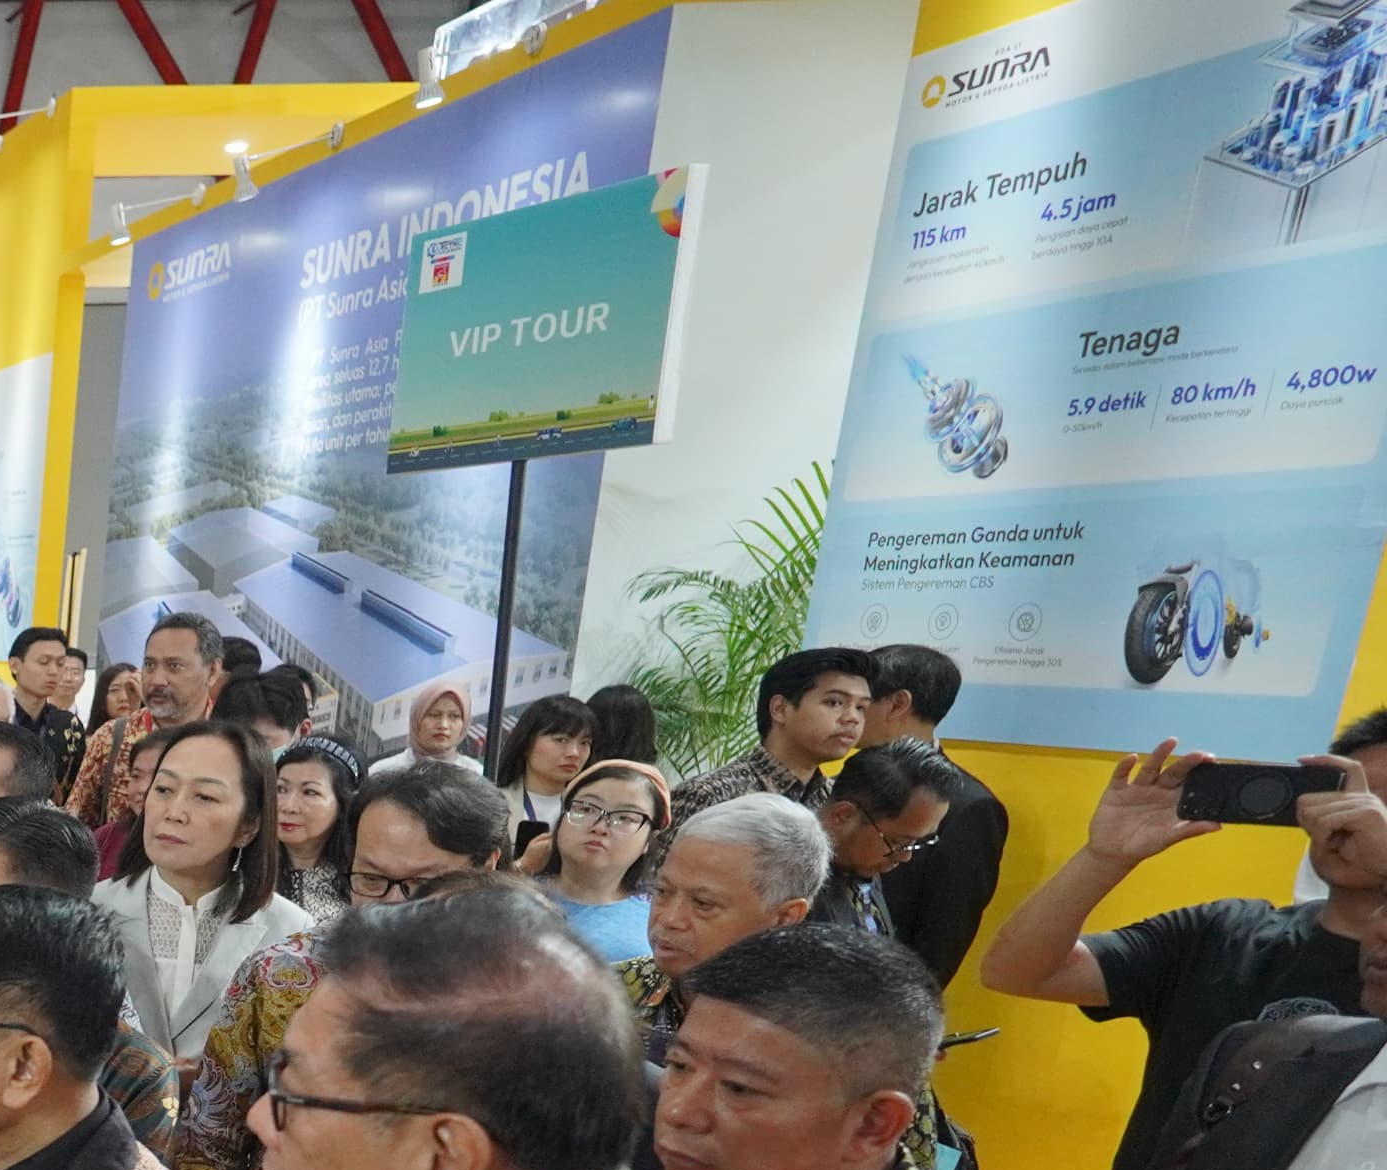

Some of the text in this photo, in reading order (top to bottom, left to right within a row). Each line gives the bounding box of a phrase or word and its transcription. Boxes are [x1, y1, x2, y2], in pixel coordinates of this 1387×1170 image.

[947, 47, 1051, 97] SUNRA
[913, 151, 1087, 218] Jarak Tempuh
[1041, 193, 1116, 222] 4.5 jam
[912, 225, 967, 250] 115 km
[163, 241, 231, 291] SUNRA
[300, 222, 391, 290] SUNRA
[326, 286, 373, 320] Sunra
[450, 323, 502, 358] VIP
[510, 303, 609, 347] TOUR
[1078, 324, 1180, 358] Tenaga
[330, 344, 361, 365] Sunra
[365, 334, 389, 356] Asia
[1170, 377, 1257, 405] 80 km/h
[1286, 364, 1378, 394] 4,800w
[1067, 391, 1147, 416] 5.9 detik
[1165, 409, 1212, 424] Kecepatan
[1280, 400, 1306, 411] Daya
[345, 431, 364, 452] per
[868, 521, 1085, 551] Pengereman Ganda untuk
[864, 551, 1075, 575] Meningkatkan Keamanan
[861, 576, 994, 592] Sistem Pengereman CBS
